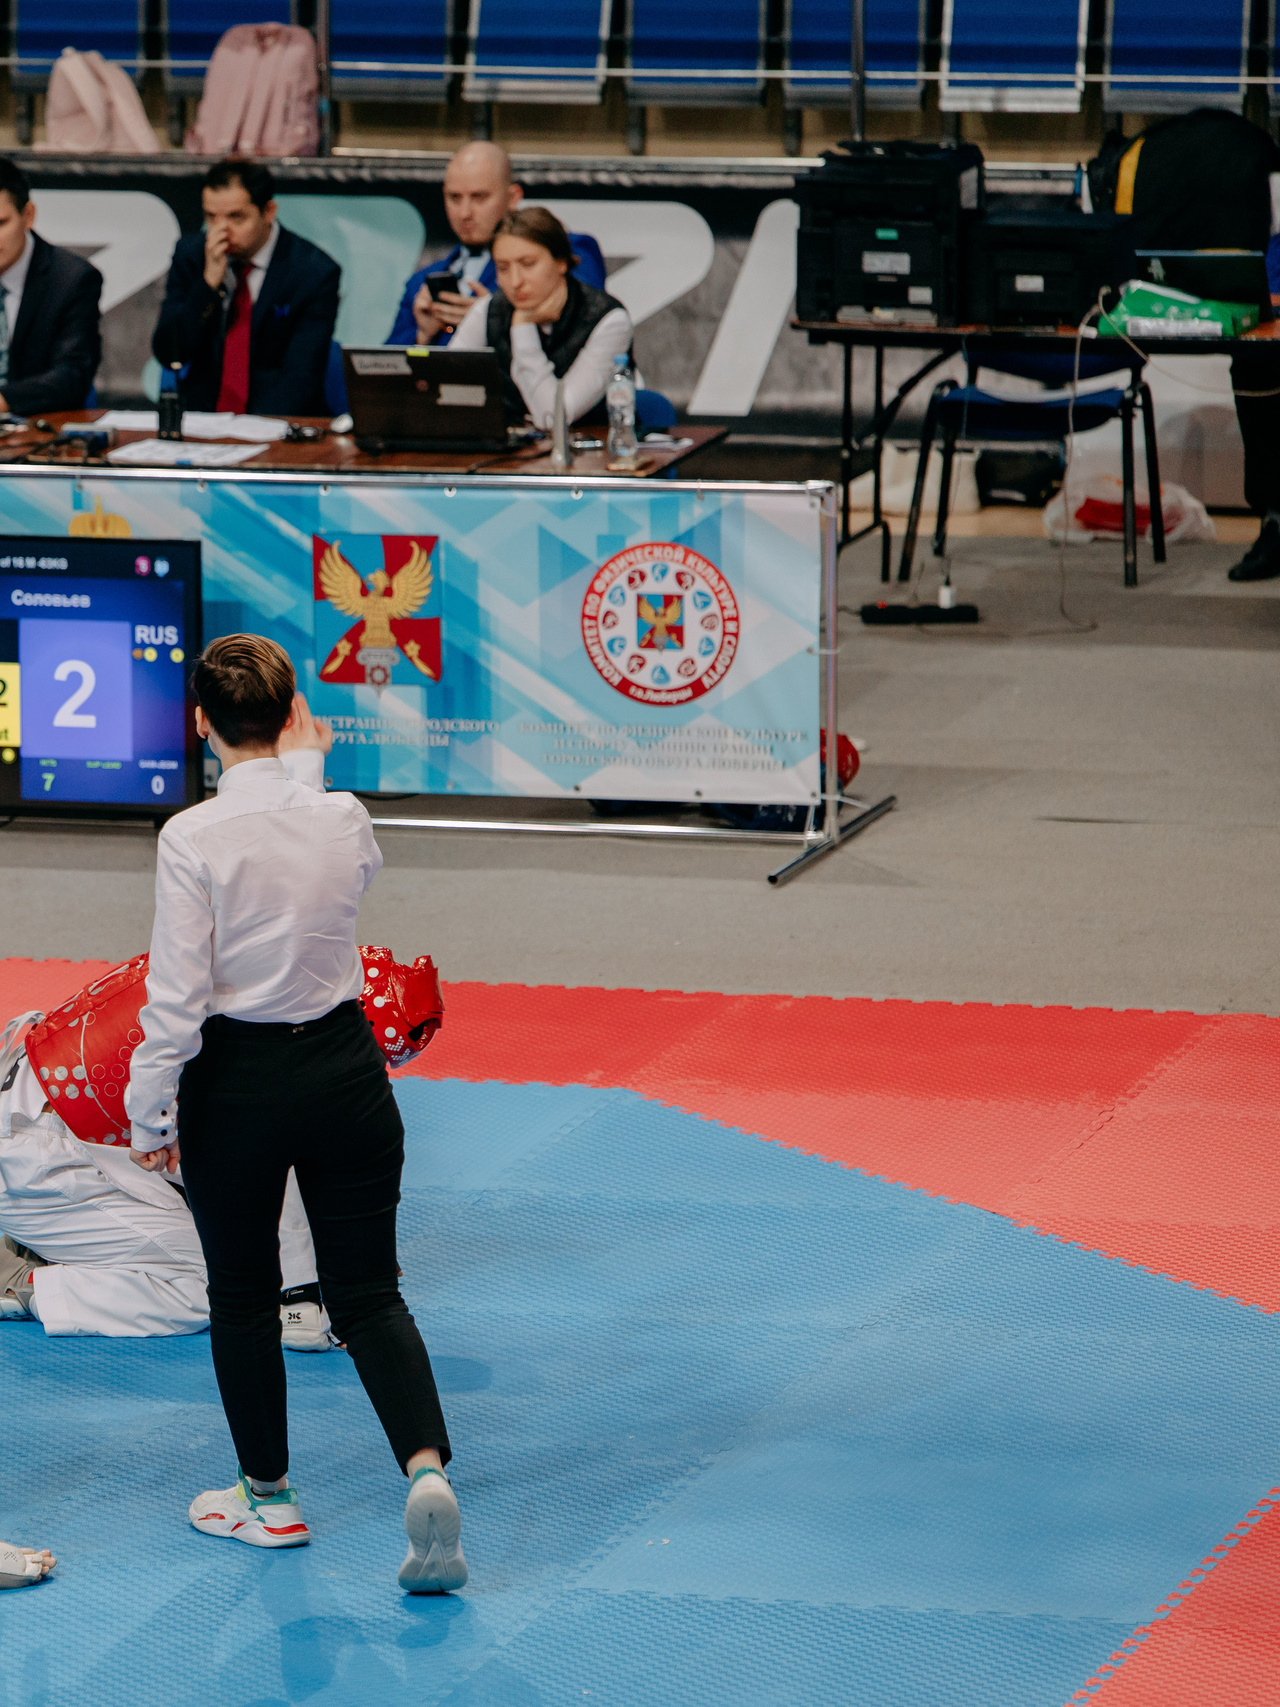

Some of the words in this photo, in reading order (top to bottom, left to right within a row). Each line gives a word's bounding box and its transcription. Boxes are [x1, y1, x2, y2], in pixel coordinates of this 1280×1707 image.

[0, 556, 11, 568] of
[11, 588, 91, 608] Соловьев
[584, 592, 601, 616] ПО
[593, 545, 685, 593] ФИЗИЧЕСКОЙ
[684, 554, 737, 619] КУЛЬТУРЕ
[724, 619, 738, 633] И
[135, 625, 179, 646] RUS
[52, 659, 97, 729] 2
[331, 730, 367, 745] РУГА
[41, 772, 56, 792] 7
[150, 775, 165, 796] 0
